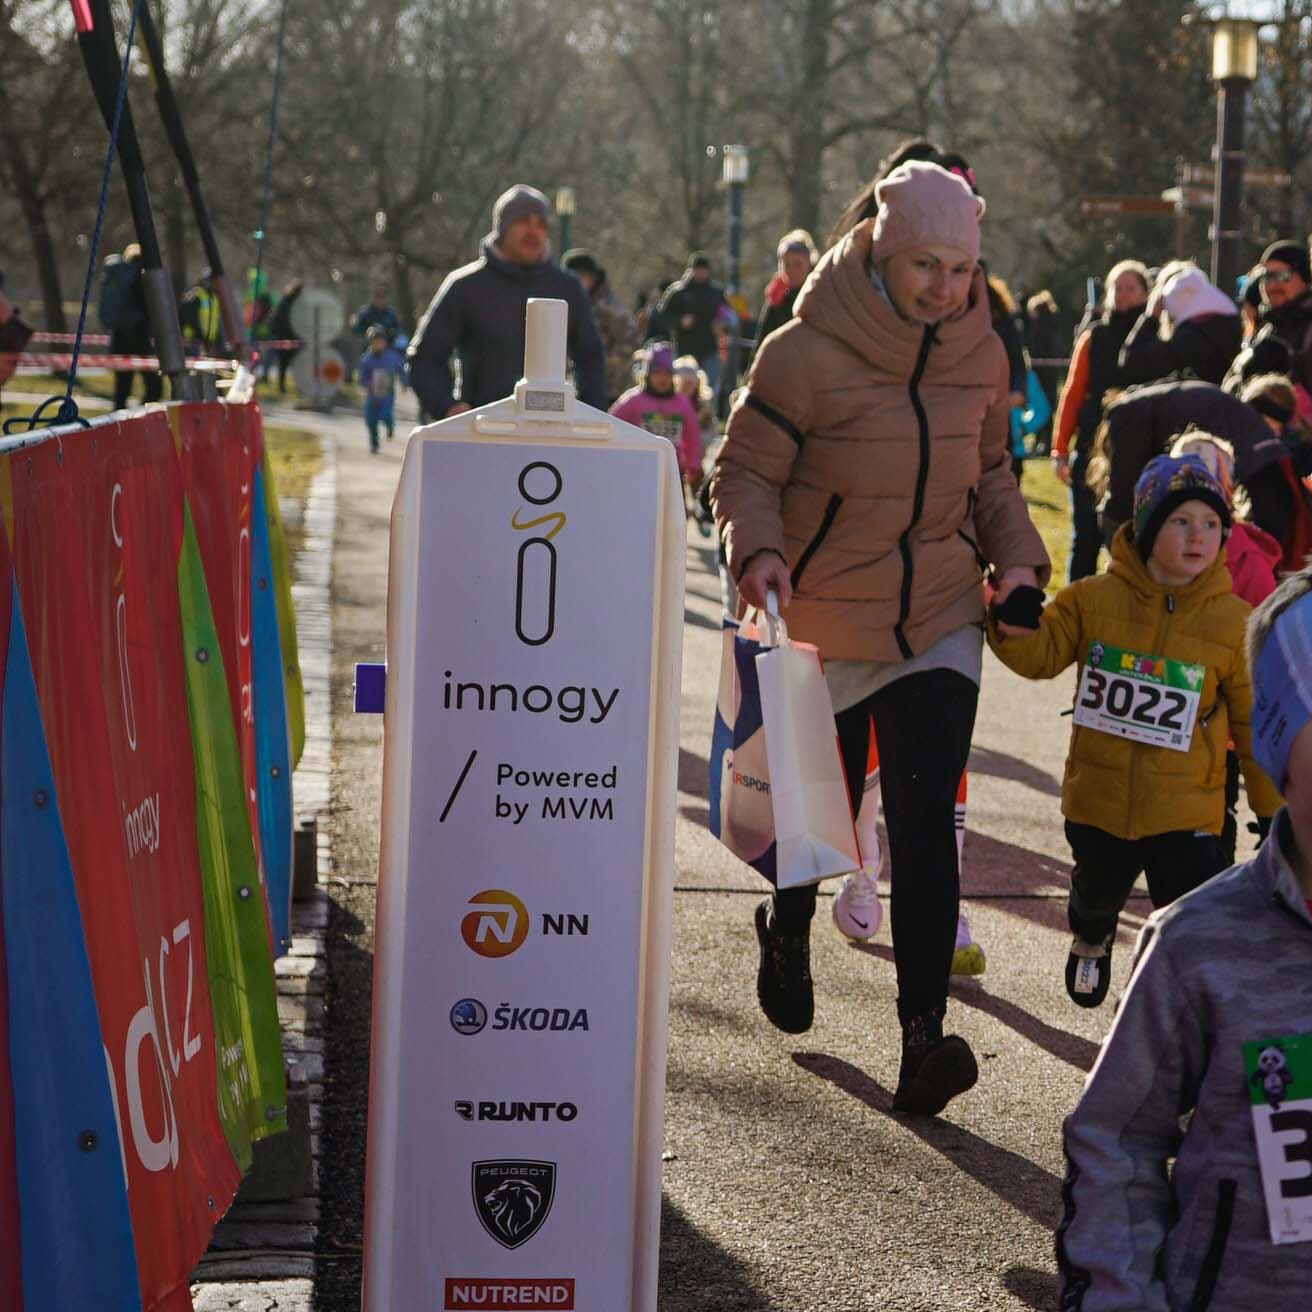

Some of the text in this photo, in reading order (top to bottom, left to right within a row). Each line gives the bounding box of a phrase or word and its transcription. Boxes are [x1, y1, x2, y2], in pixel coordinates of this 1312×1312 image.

[444, 670, 620, 724] innogy
[1080, 670, 1188, 731] 3022
[497, 763, 617, 789] Powered
[495, 794, 614, 825] by MVM
[542, 913, 590, 936] NN
[492, 1001, 590, 1032] ŠKODA
[478, 1101, 578, 1123] RUNTO
[480, 1167, 548, 1177] PEUGEOT
[452, 1286, 569, 1304] NUTREND
